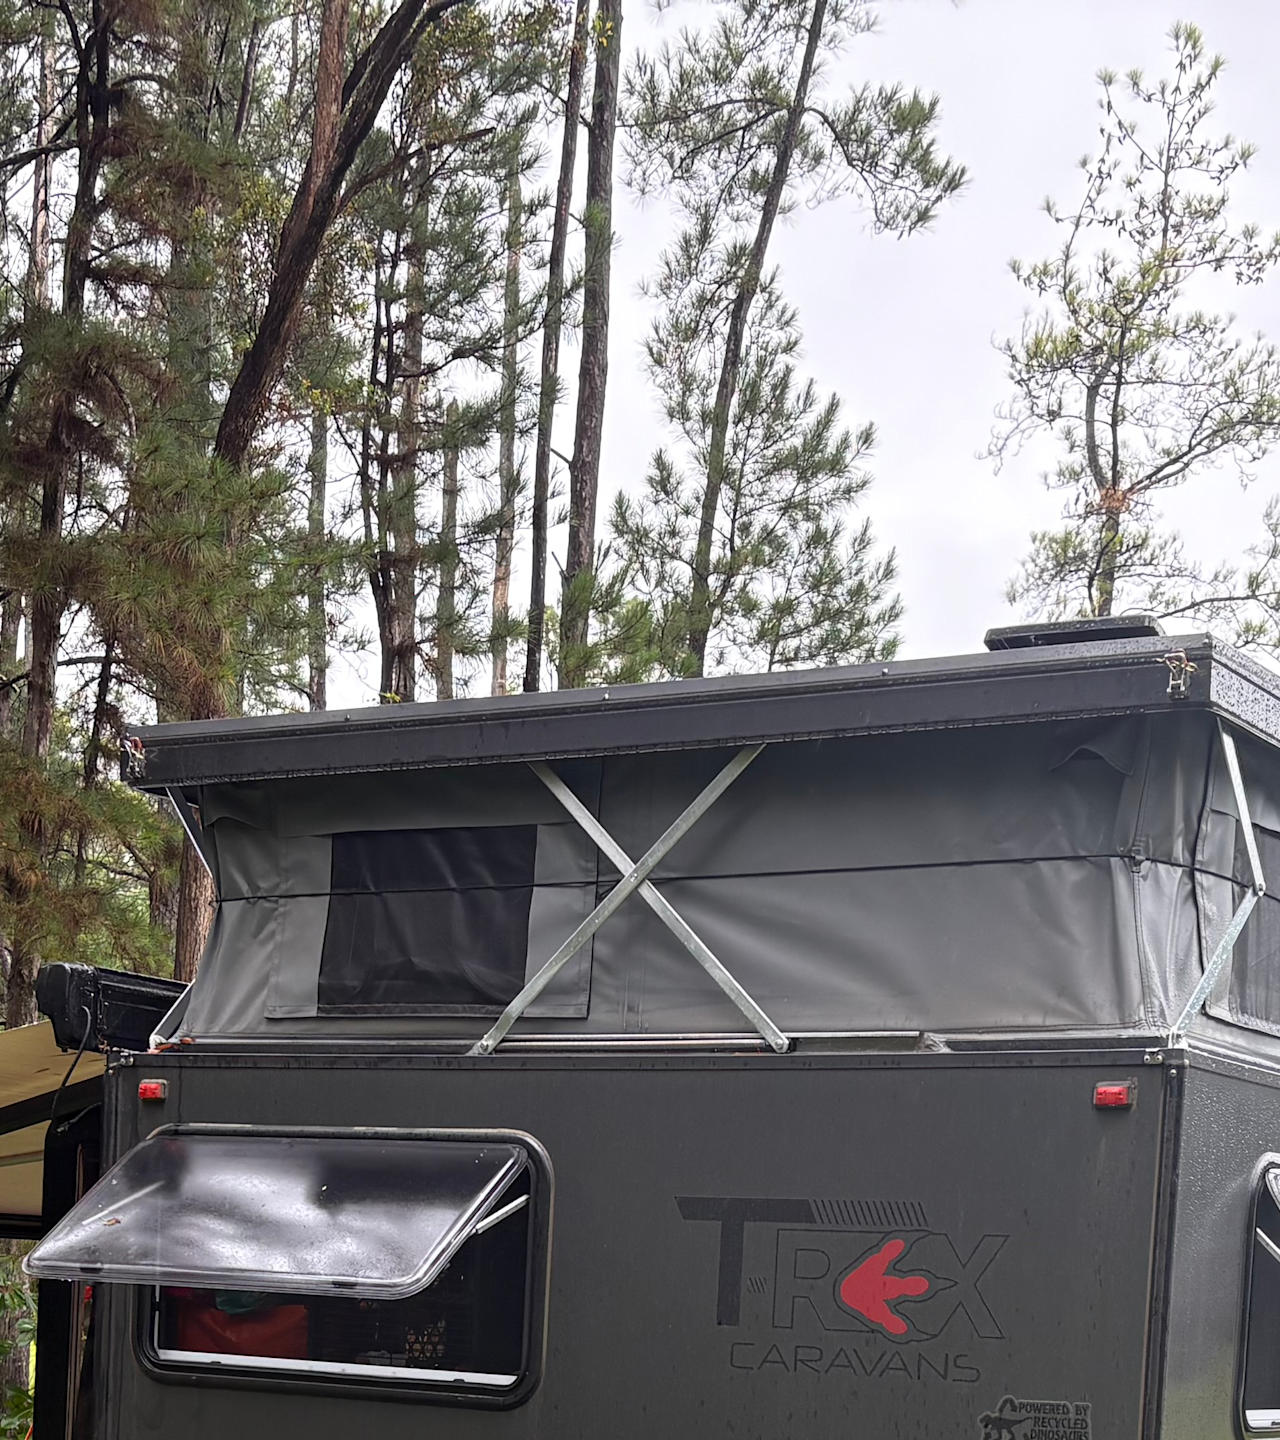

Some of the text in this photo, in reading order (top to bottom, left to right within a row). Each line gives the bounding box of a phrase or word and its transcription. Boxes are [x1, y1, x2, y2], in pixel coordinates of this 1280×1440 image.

[729, 1342, 982, 1383] CARAVANS
[1018, 1402, 1089, 1416] POWERED BY
[1033, 1416, 1089, 1430] RECYCLED
